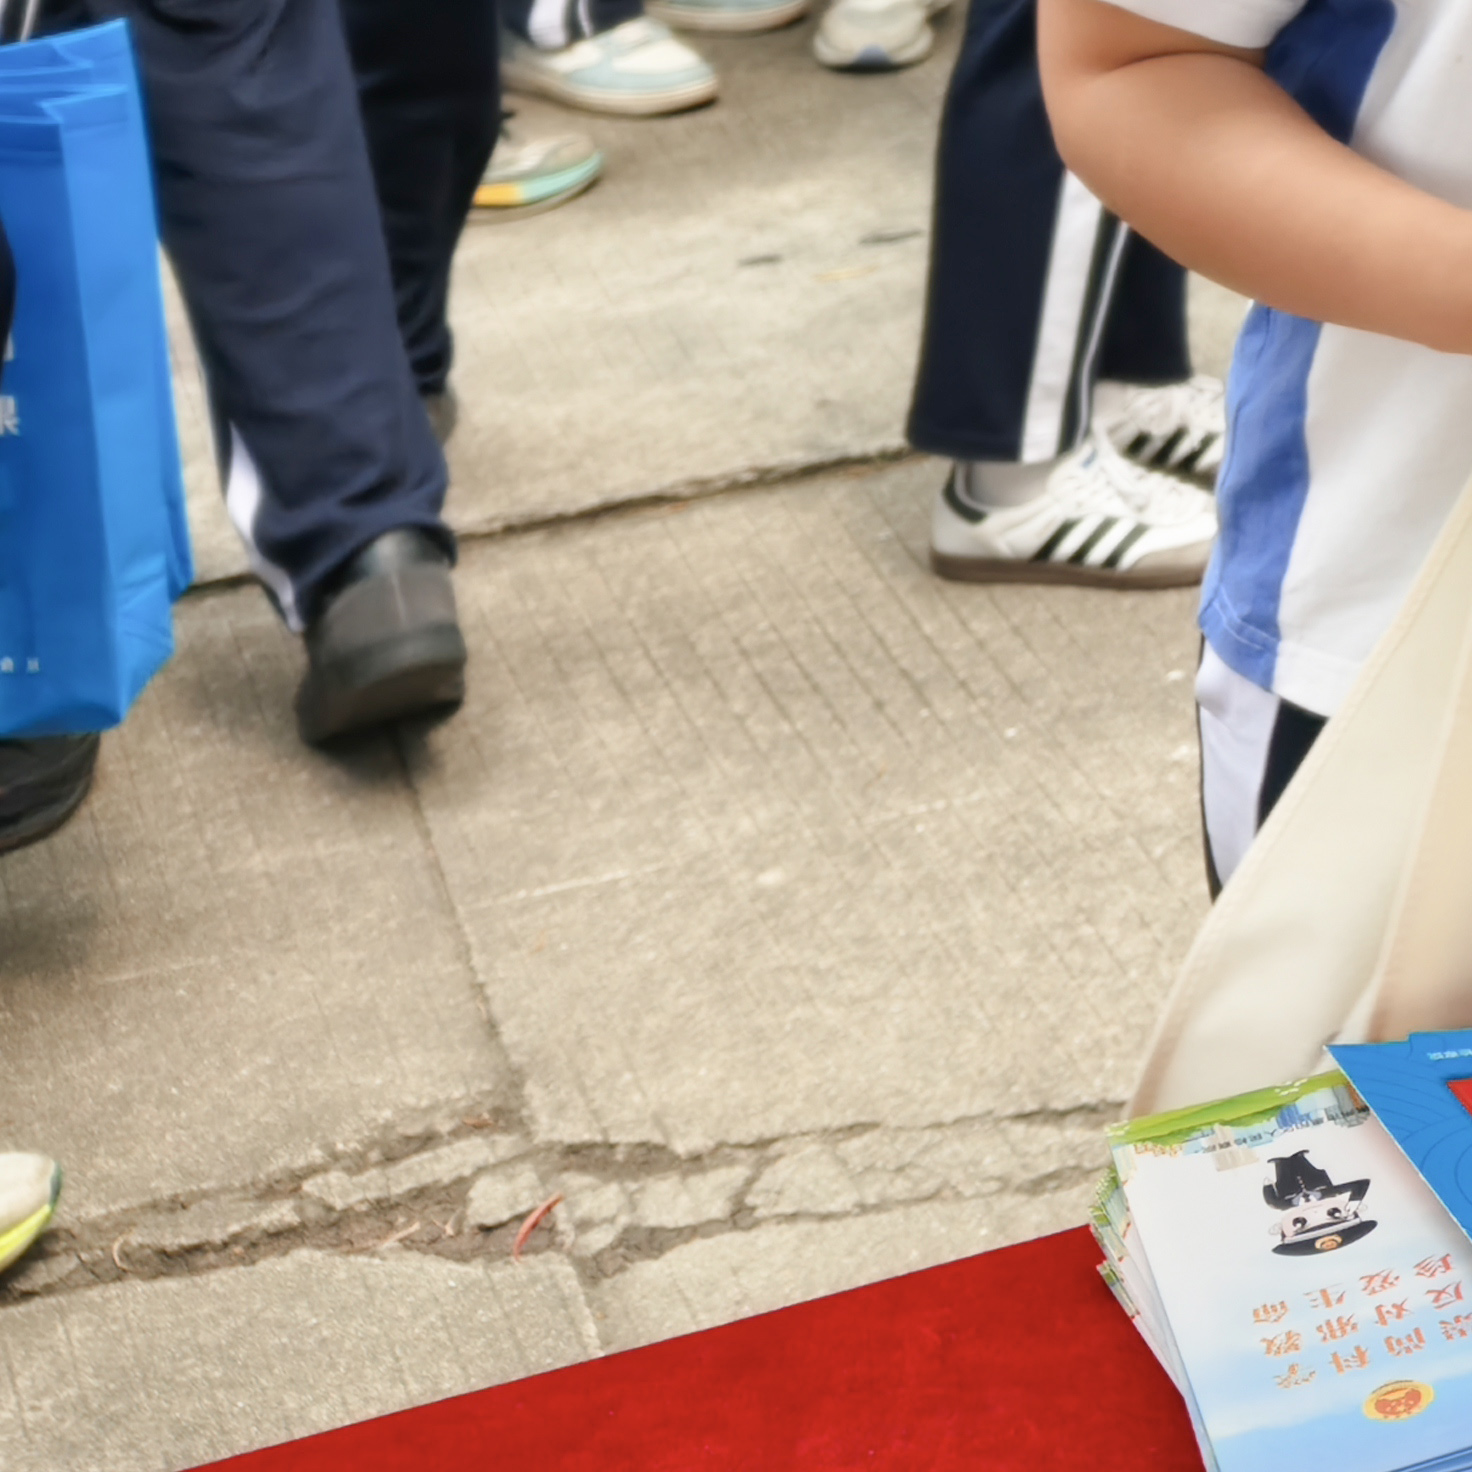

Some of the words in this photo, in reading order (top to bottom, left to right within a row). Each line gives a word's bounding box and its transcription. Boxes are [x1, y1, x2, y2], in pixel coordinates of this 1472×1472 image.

[1251, 1252, 1456, 1326] 珍爱生命
[1259, 1280, 1467, 1357] 反对邪教
